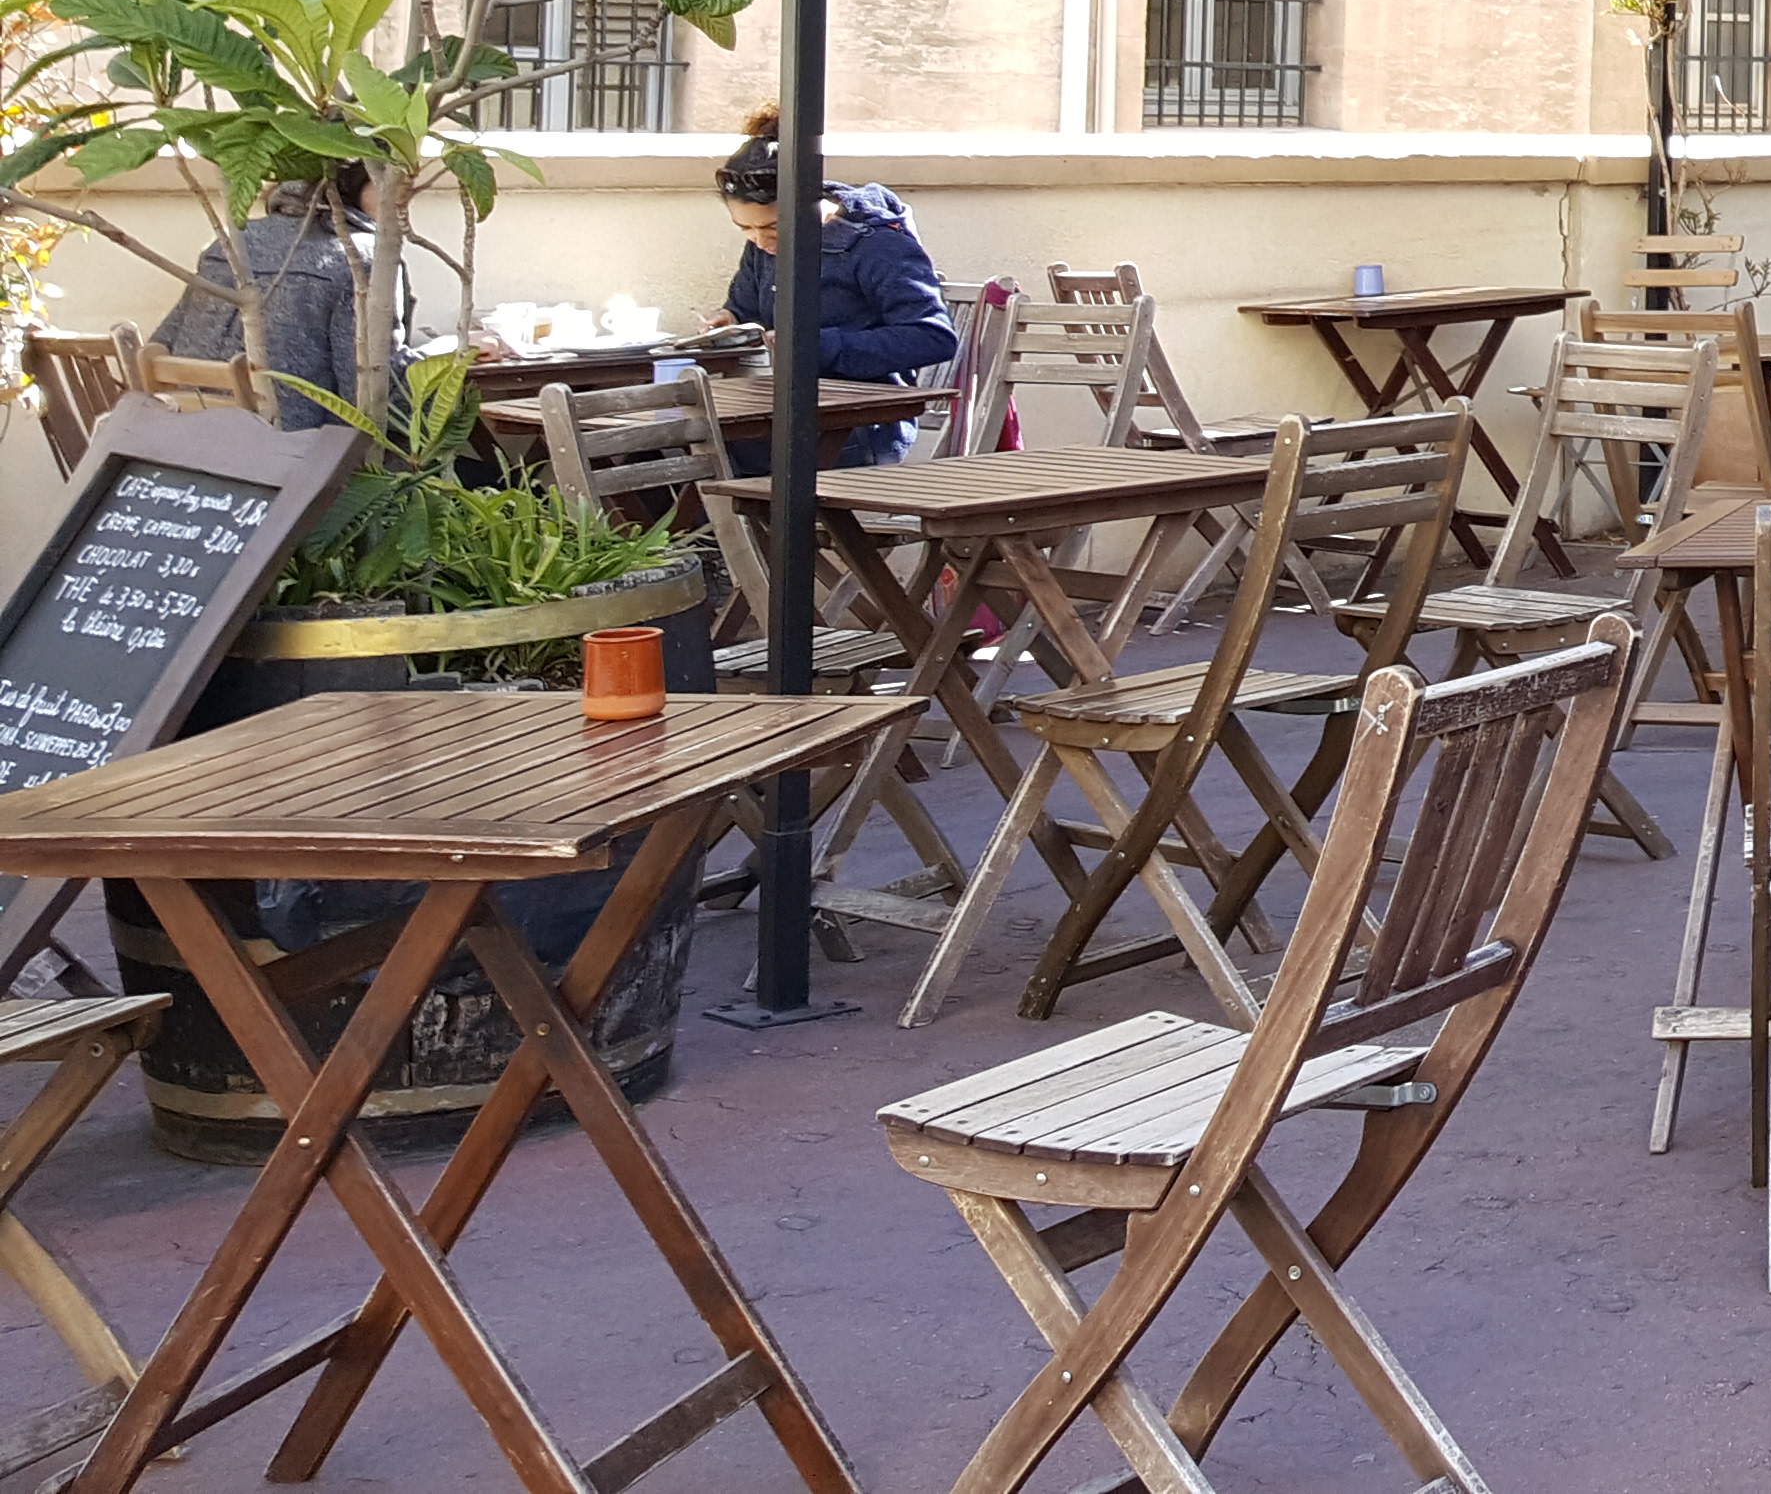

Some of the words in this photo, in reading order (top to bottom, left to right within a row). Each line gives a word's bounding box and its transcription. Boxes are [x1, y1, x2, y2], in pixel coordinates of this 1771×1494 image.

[116, 472, 161, 500] CAFÉ
[96, 505, 142, 538] CRÈME,
[76, 544, 153, 569] CHOCOLAT
[55, 568, 107, 603] THÉ
[61, 606, 80, 634] la
